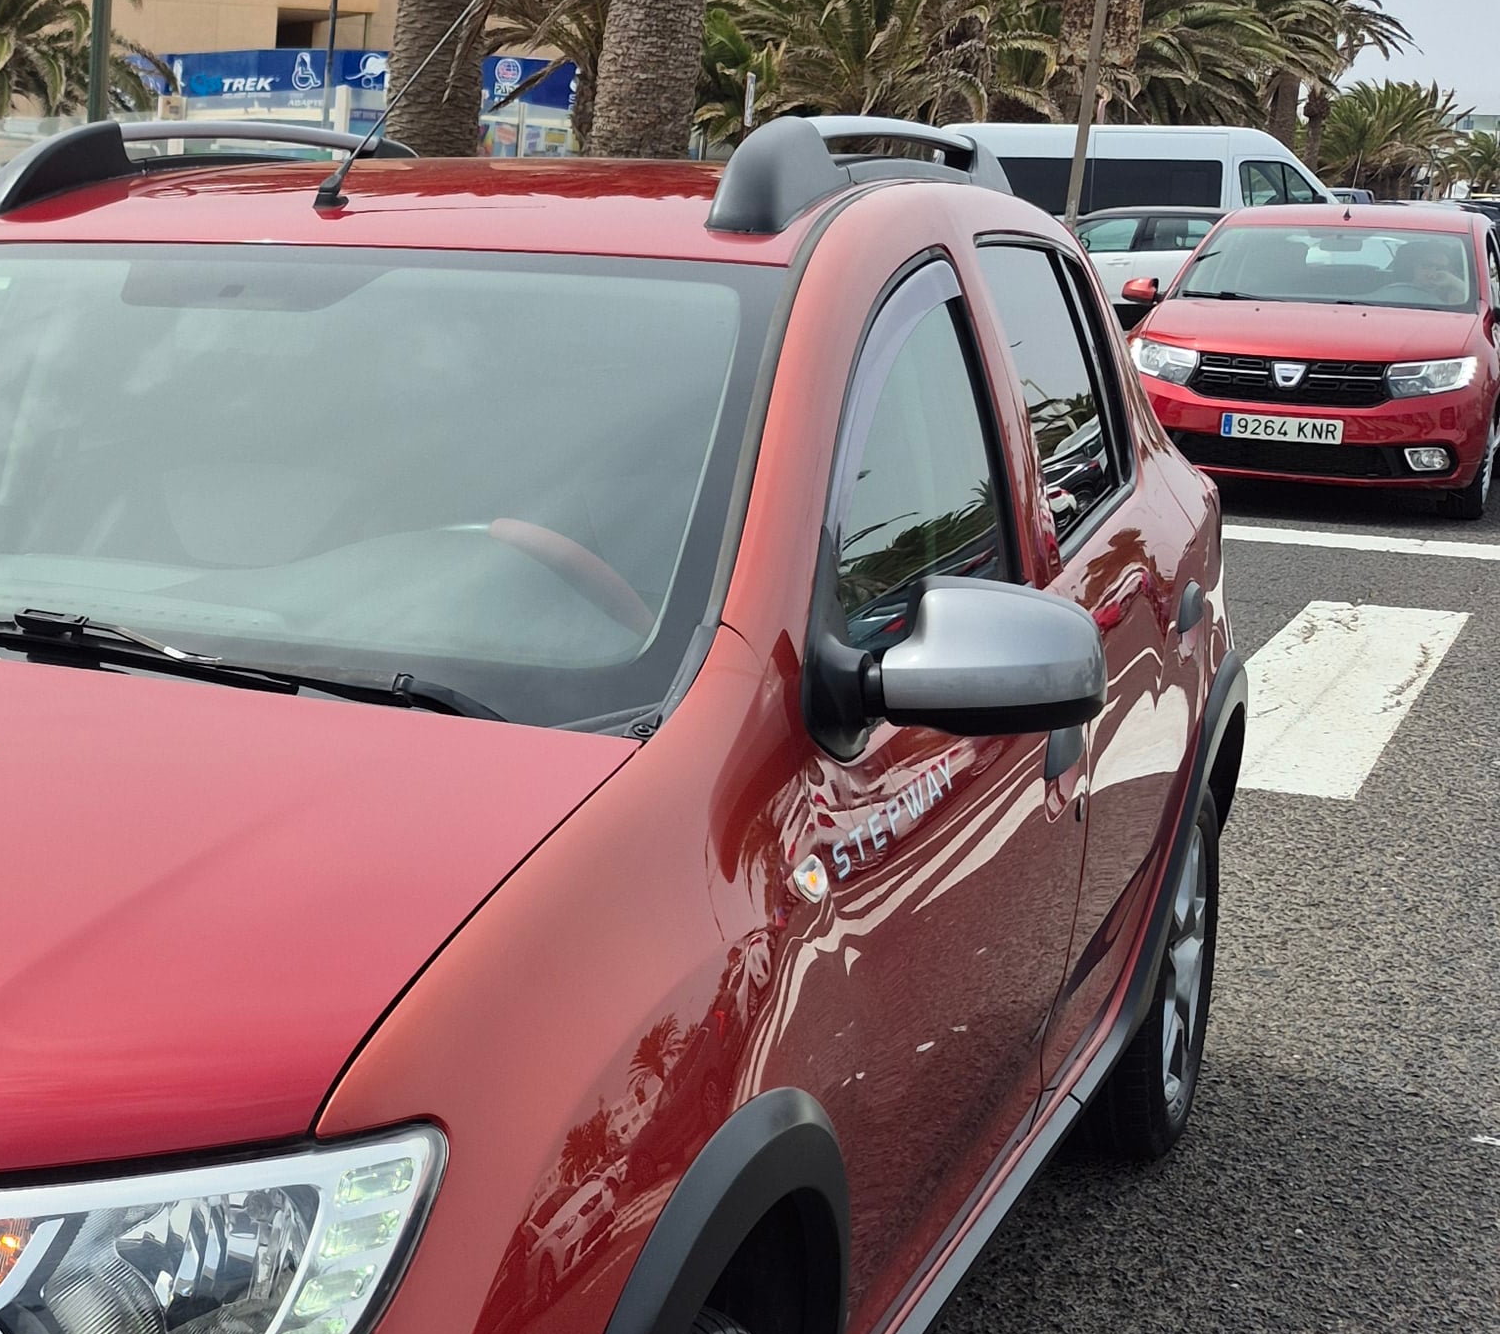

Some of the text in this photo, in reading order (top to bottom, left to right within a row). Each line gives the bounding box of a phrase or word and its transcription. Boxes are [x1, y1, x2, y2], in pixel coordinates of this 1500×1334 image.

[1236, 417, 1338, 441] 9264 KNR
[831, 755, 953, 881] STEPWAY
